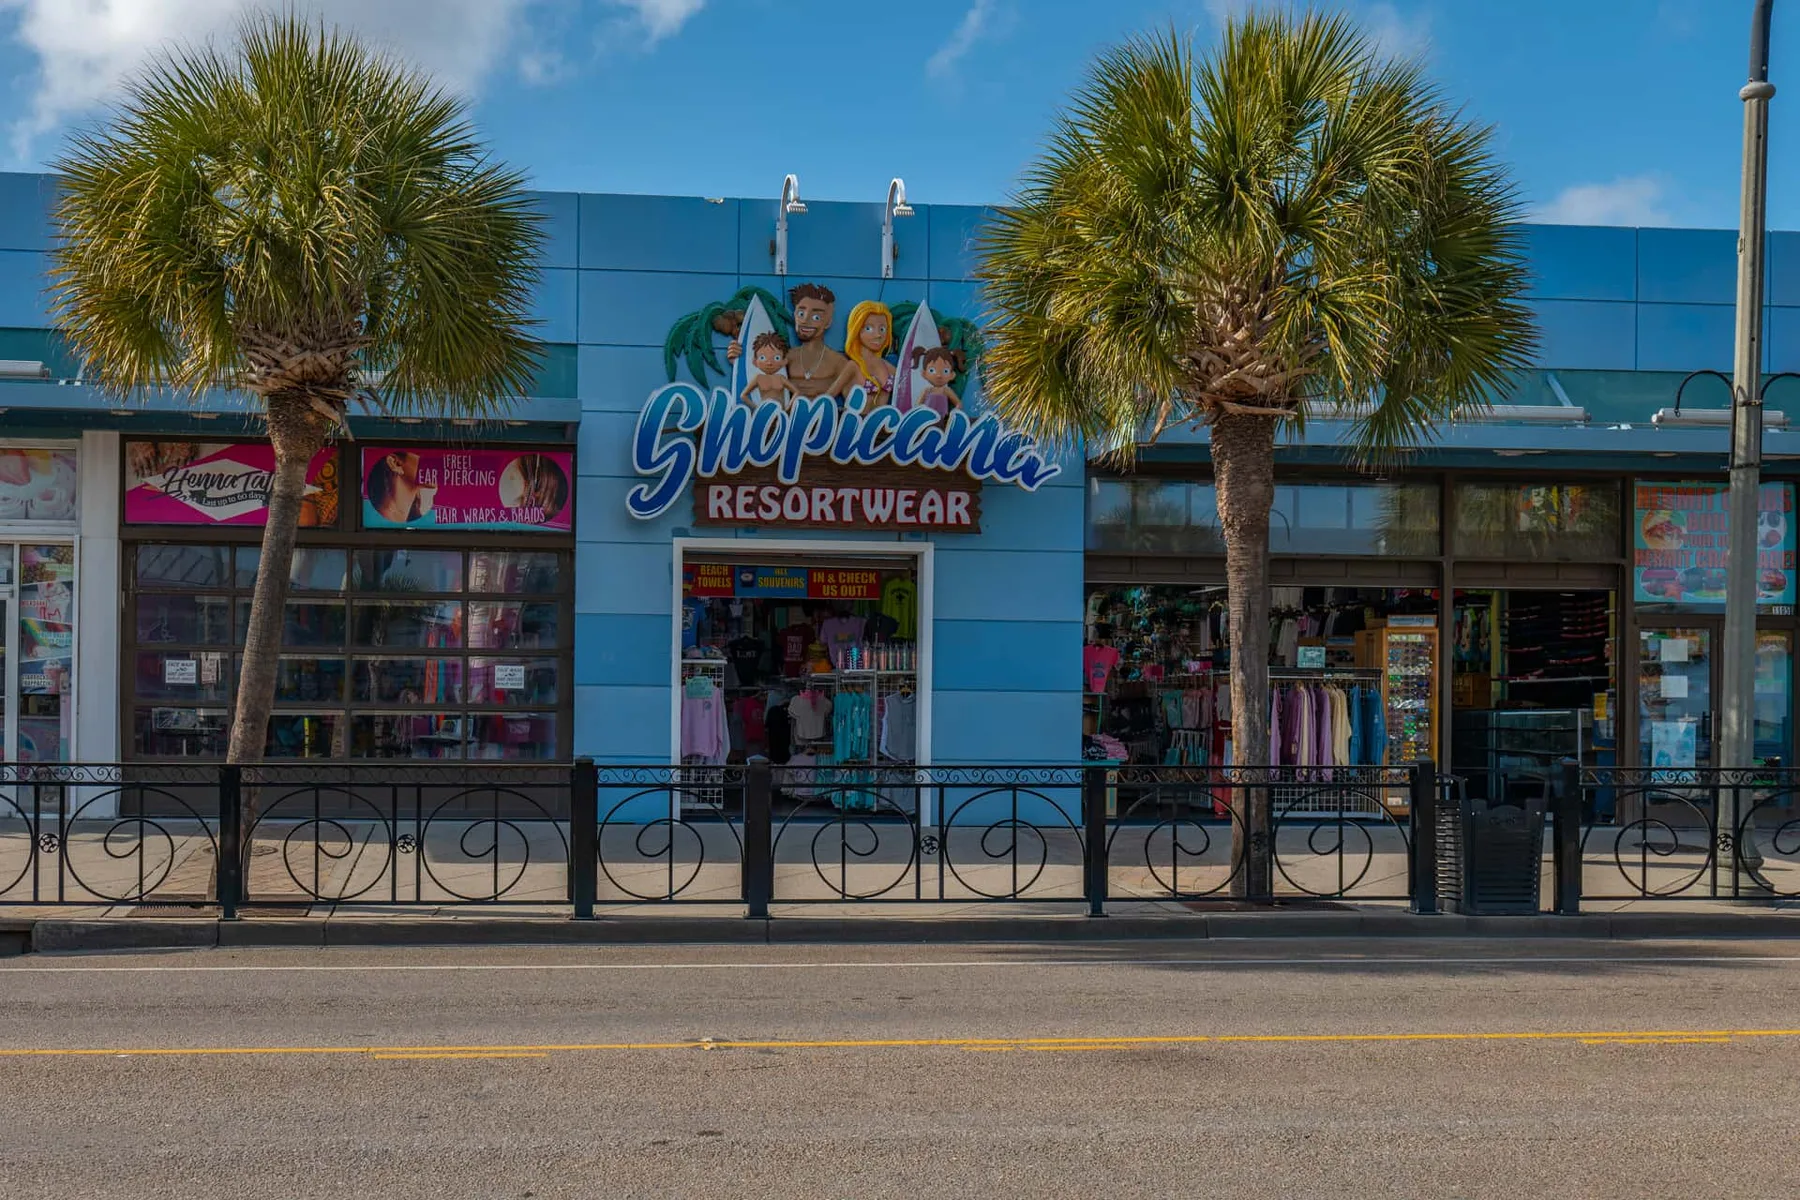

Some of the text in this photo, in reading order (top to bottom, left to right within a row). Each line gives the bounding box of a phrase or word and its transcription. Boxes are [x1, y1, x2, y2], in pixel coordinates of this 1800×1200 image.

[625, 381, 1062, 521] Shopicana
[161, 465, 238, 494] Henna
[418, 468, 496, 487] EAR PIERCING
[202, 491, 267, 506] Last up to 60 days
[707, 484, 971, 525] RESORTWEAR
[1635, 486, 1716, 510] HERMIT
[434, 506, 545, 524] HAIR WRAPS & BRAIDS
[1687, 512, 1731, 531] BUIL
[1634, 549, 1691, 568] HERMIT
[700, 564, 729, 576] BEACH
[813, 572, 876, 584] IN & CHECK
[697, 576, 732, 588] TOWELS
[758, 576, 805, 589] SOUVENIRS
[822, 584, 867, 597] US OUT!
